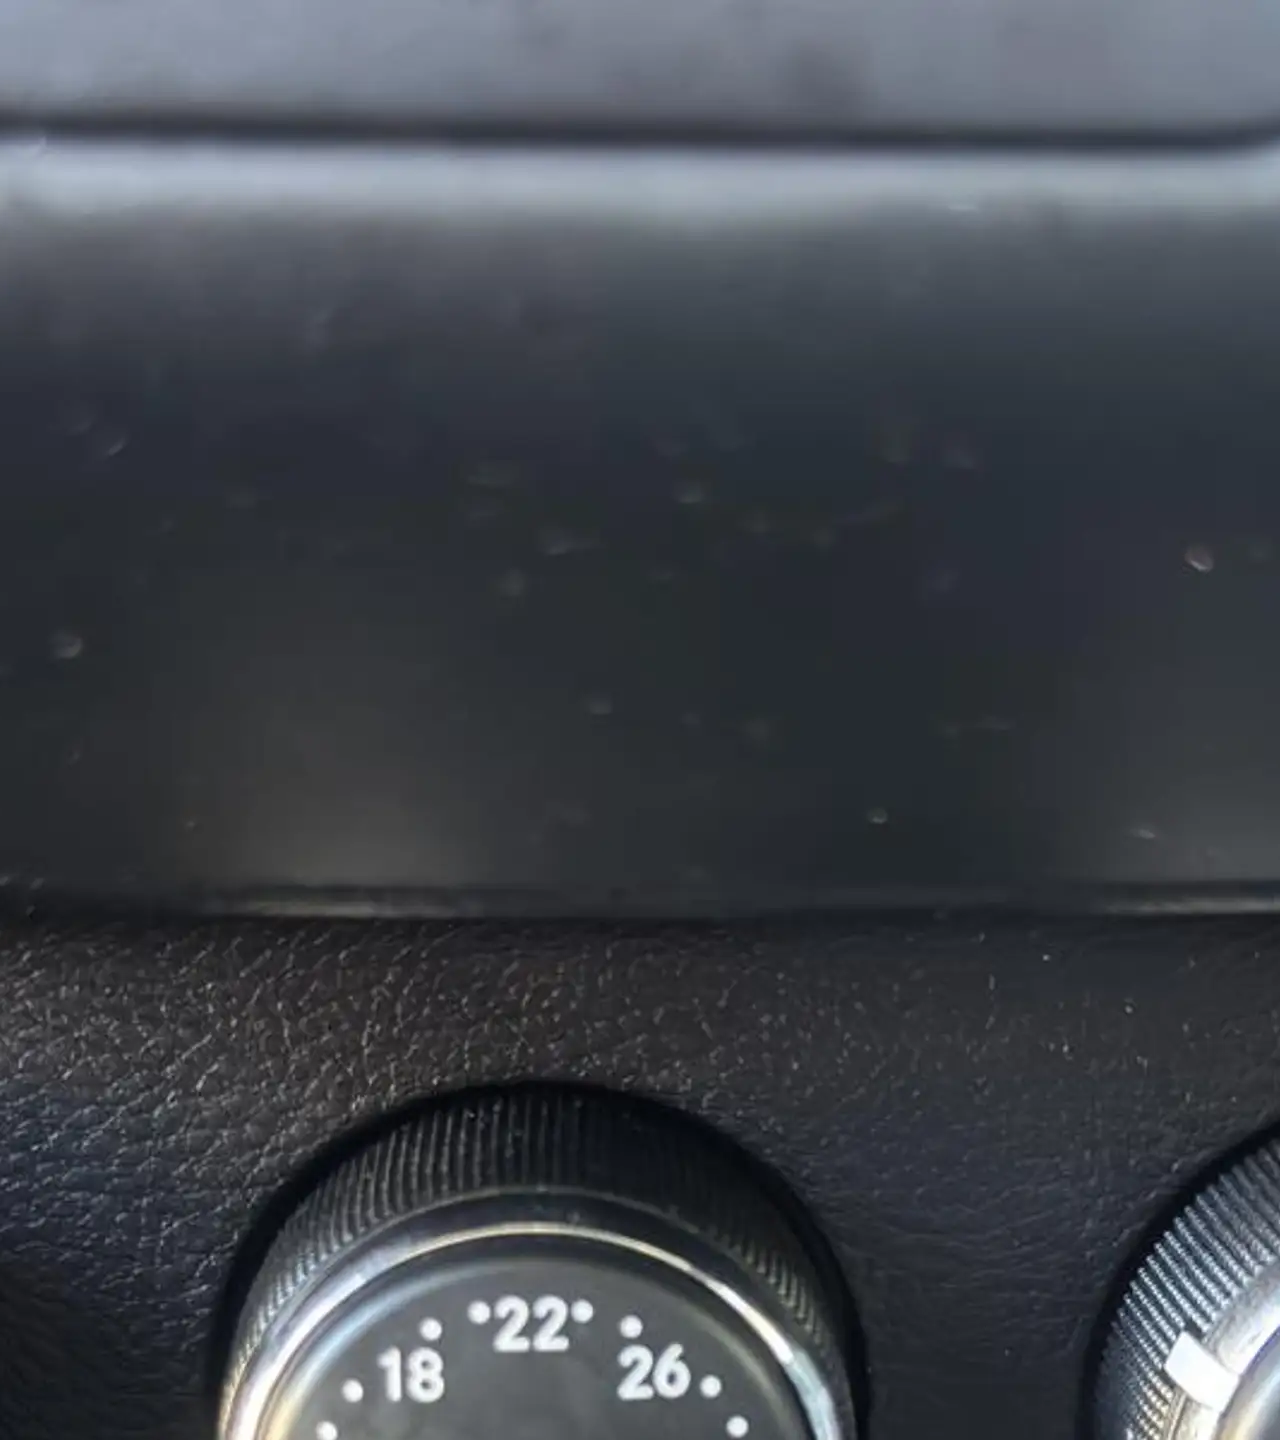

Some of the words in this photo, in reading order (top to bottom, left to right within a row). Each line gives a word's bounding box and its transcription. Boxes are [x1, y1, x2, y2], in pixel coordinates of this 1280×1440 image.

[490, 1294, 571, 1354] 22
[376, 1346, 446, 1404] 18
[617, 1342, 692, 1400] 26
